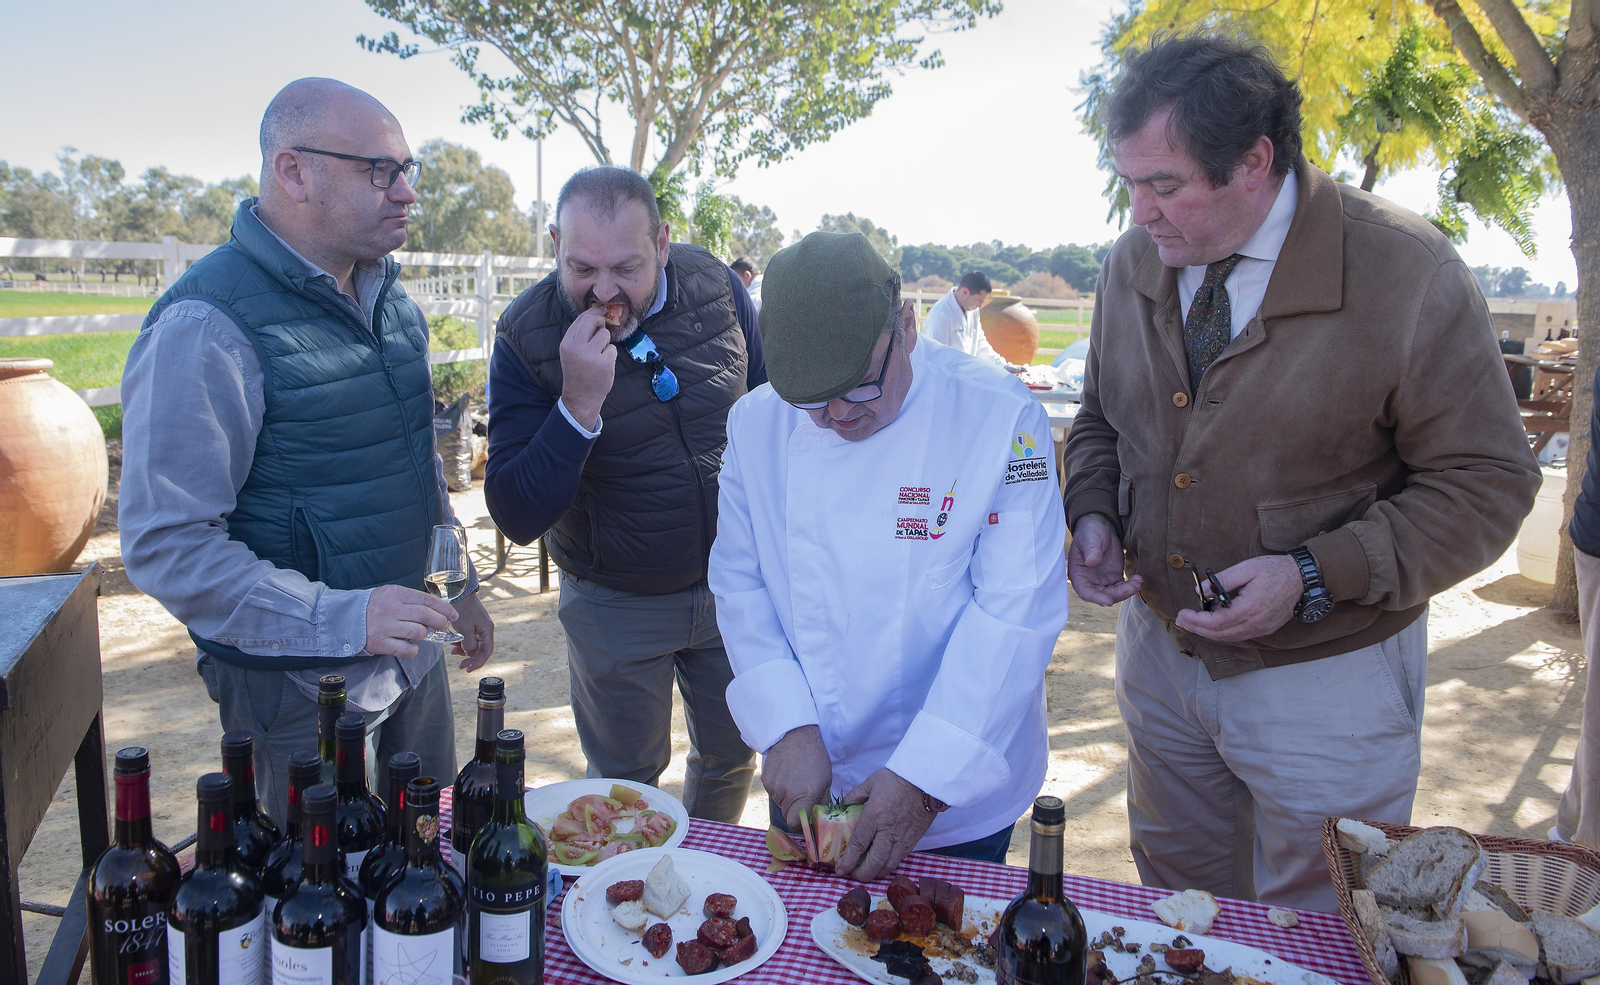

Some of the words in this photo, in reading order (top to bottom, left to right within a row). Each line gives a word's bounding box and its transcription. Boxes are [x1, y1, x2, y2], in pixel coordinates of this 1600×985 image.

[1005, 473, 1016, 481] de
[1017, 469, 1048, 478] Valladolid
[896, 522, 929, 530] MUNDIAL
[472, 885, 496, 902] TIO
[504, 884, 540, 903] PEPE
[119, 925, 167, 954] 1847
[134, 969, 154, 978] CREAM
